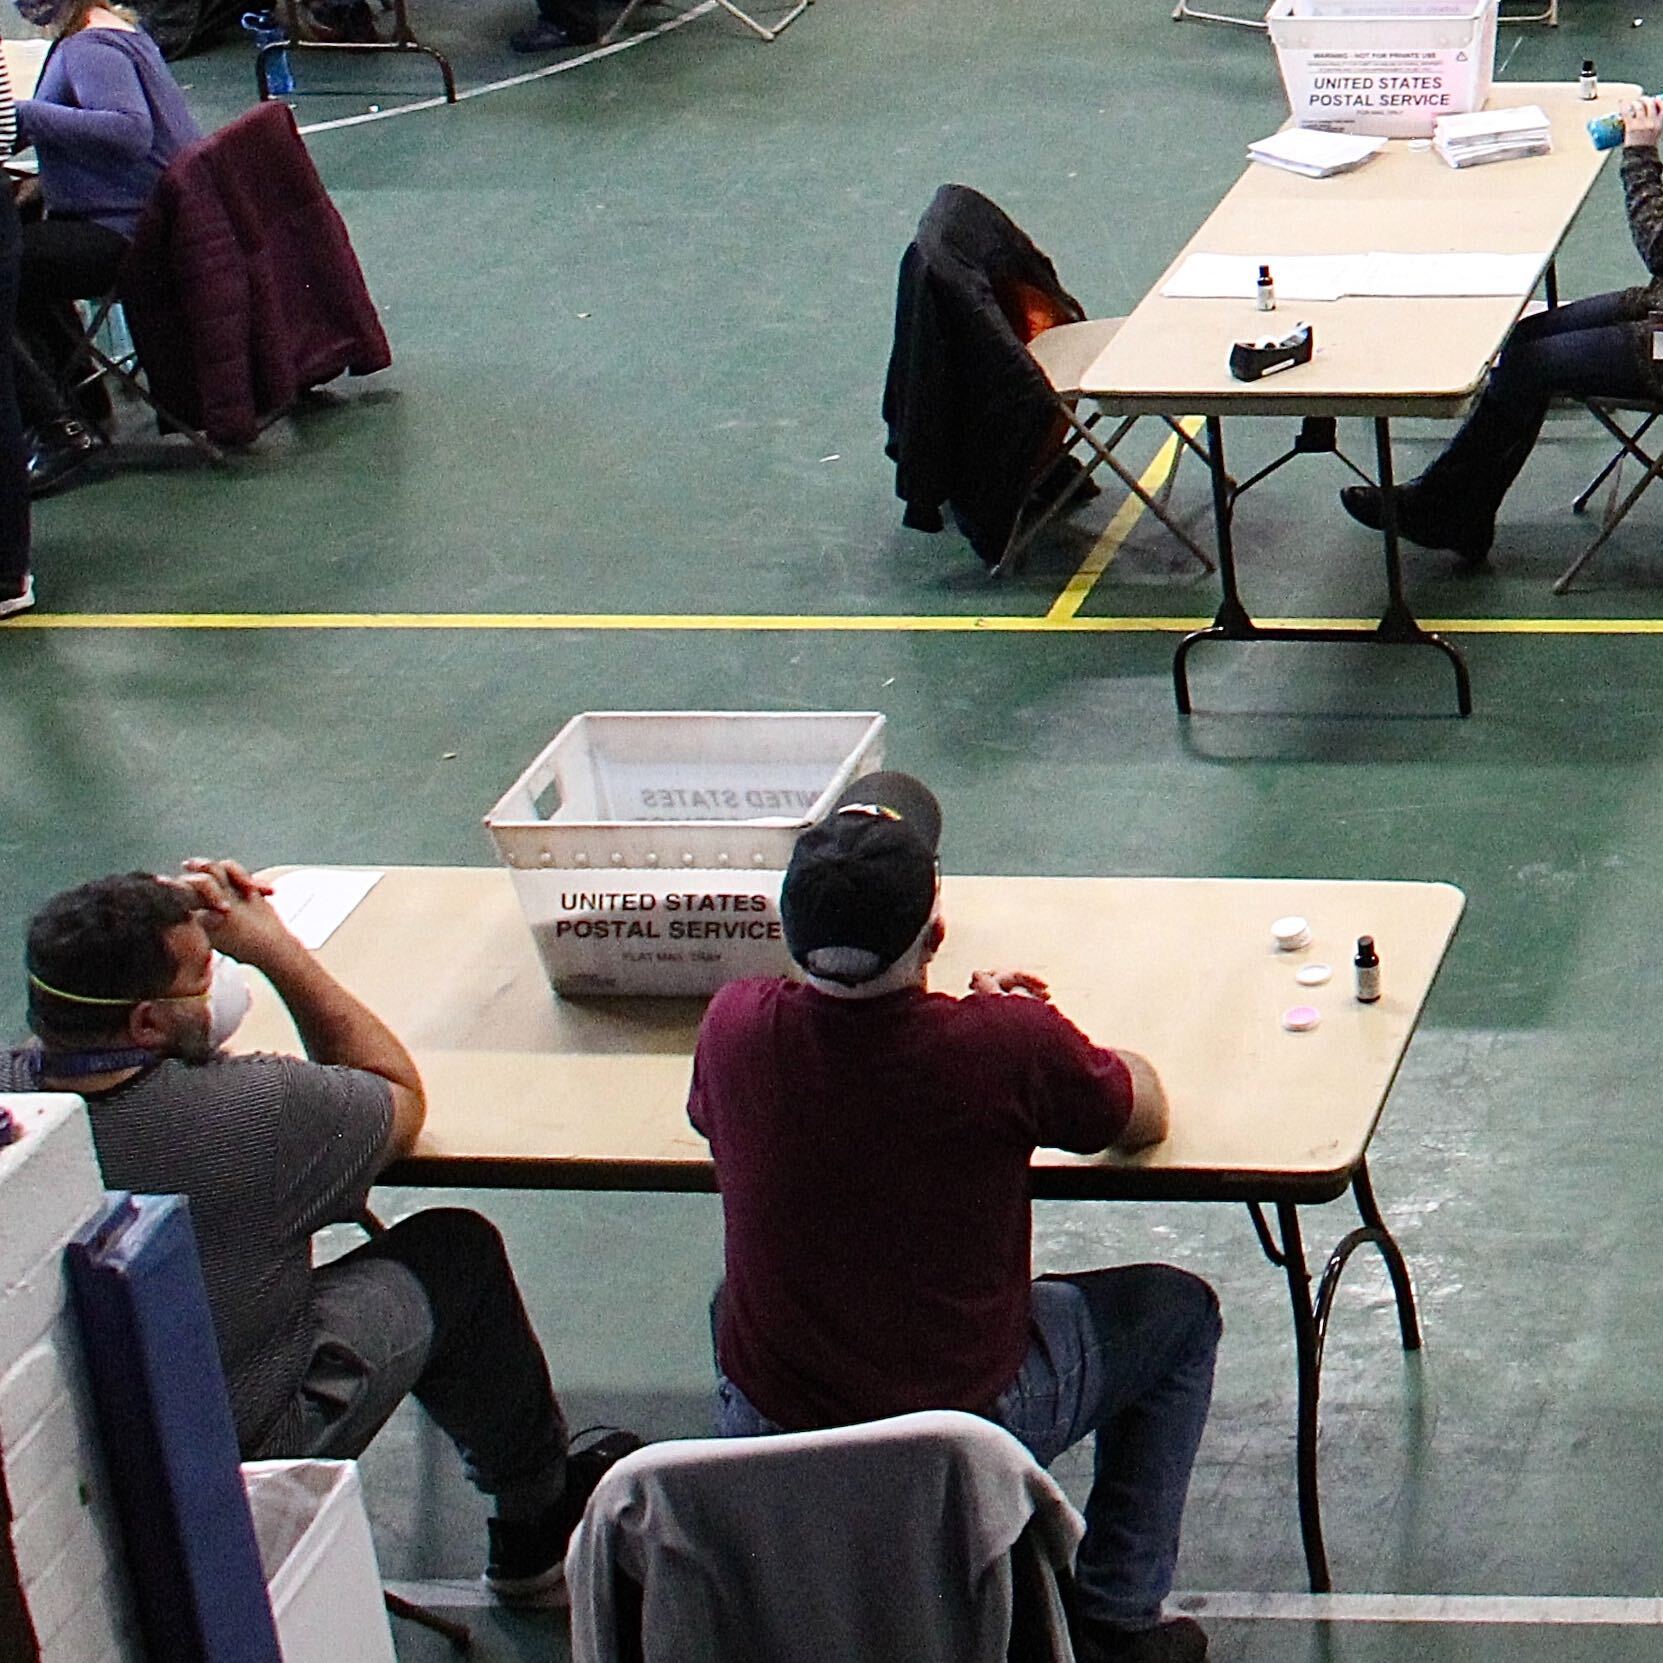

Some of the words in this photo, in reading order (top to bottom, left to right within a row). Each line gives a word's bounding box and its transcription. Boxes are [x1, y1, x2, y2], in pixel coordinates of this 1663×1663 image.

[1314, 77, 1374, 90] UNITED
[1378, 77, 1442, 90] STATES
[1309, 94, 1374, 107] POSTAL
[1379, 93, 1451, 107] SERVICE
[560, 892, 656, 912] UNITED
[665, 893, 767, 913] STATES
[556, 919, 661, 939] POSTAL
[669, 920, 783, 940] SERVICE
